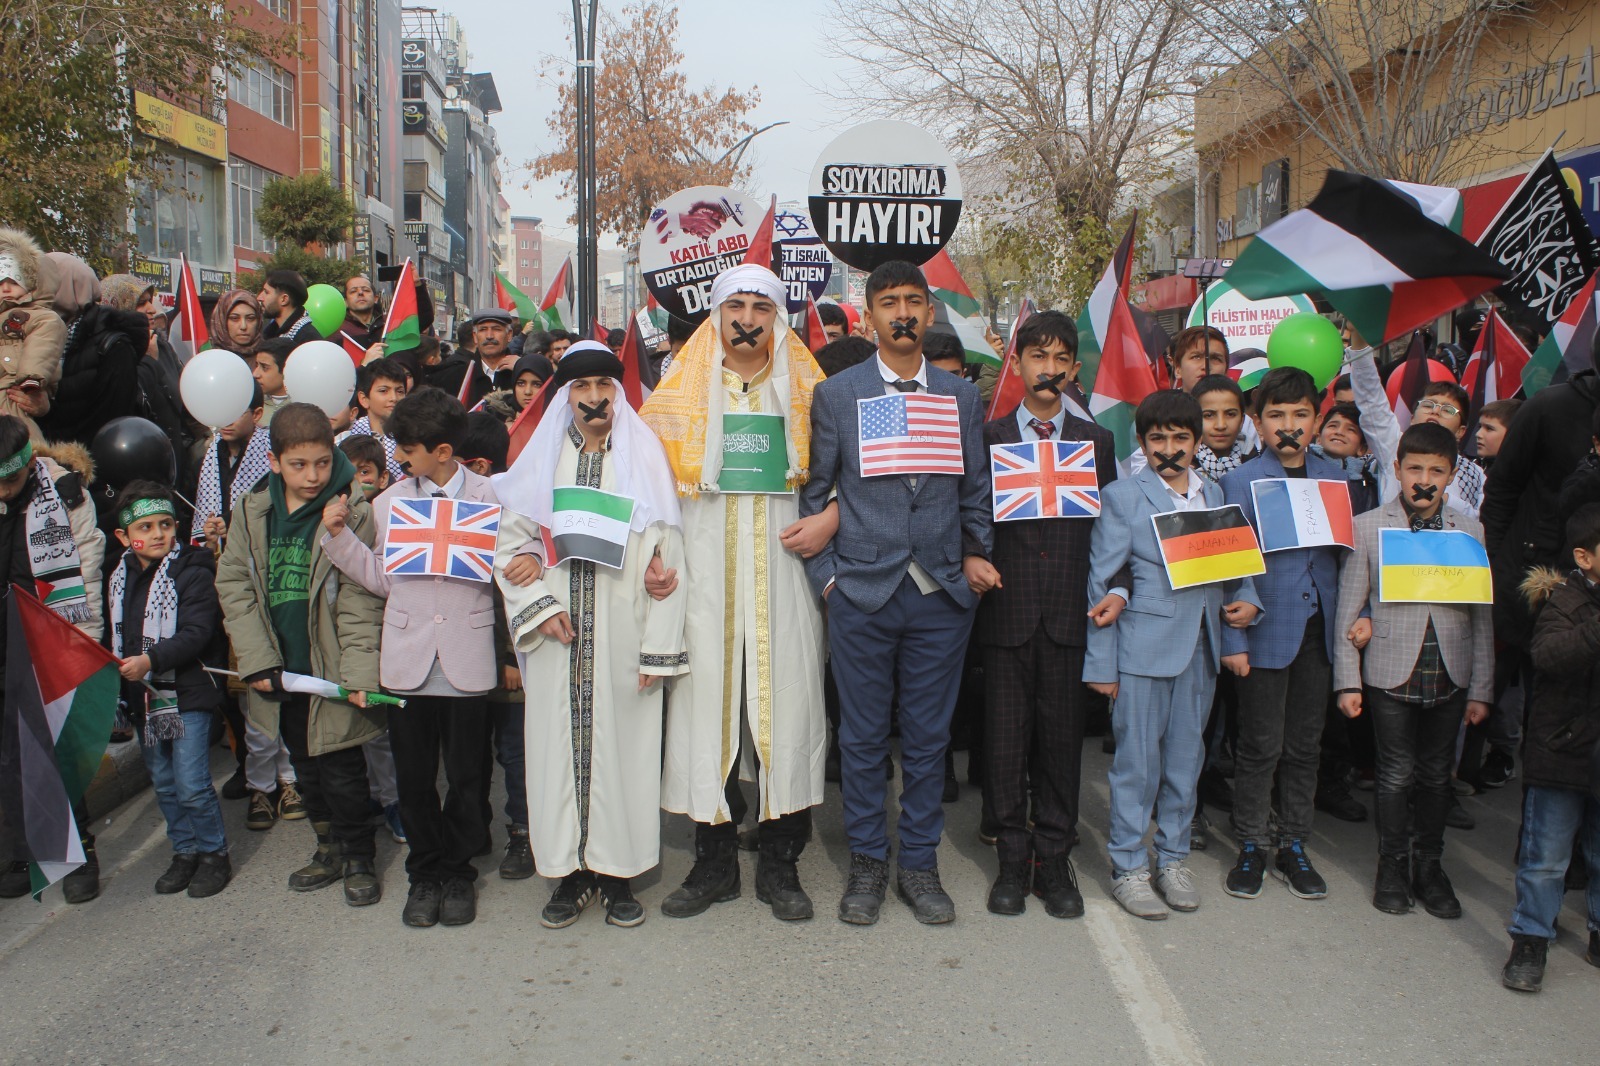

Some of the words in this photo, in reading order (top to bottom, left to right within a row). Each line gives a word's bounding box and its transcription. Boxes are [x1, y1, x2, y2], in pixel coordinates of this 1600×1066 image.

[827, 168, 941, 195] SOYKIRIMA
[828, 201, 941, 245] HAYIR!
[669, 241, 714, 265] KATİL
[717, 233, 749, 254] ABD
[795, 247, 830, 262] İSRAİL
[655, 253, 748, 288] ORTADOĞU'
[782, 263, 825, 281] İN'DEN
[1211, 308, 1258, 323] FİLİSTİN
[1250, 322, 1278, 336] DEĞİ
[909, 431, 934, 444] ABD
[563, 514, 599, 528] BAE
[1299, 489, 1320, 535] FRANSA
[1188, 534, 1240, 553] ALMANYA
[1411, 567, 1465, 577] UKRAYNA
